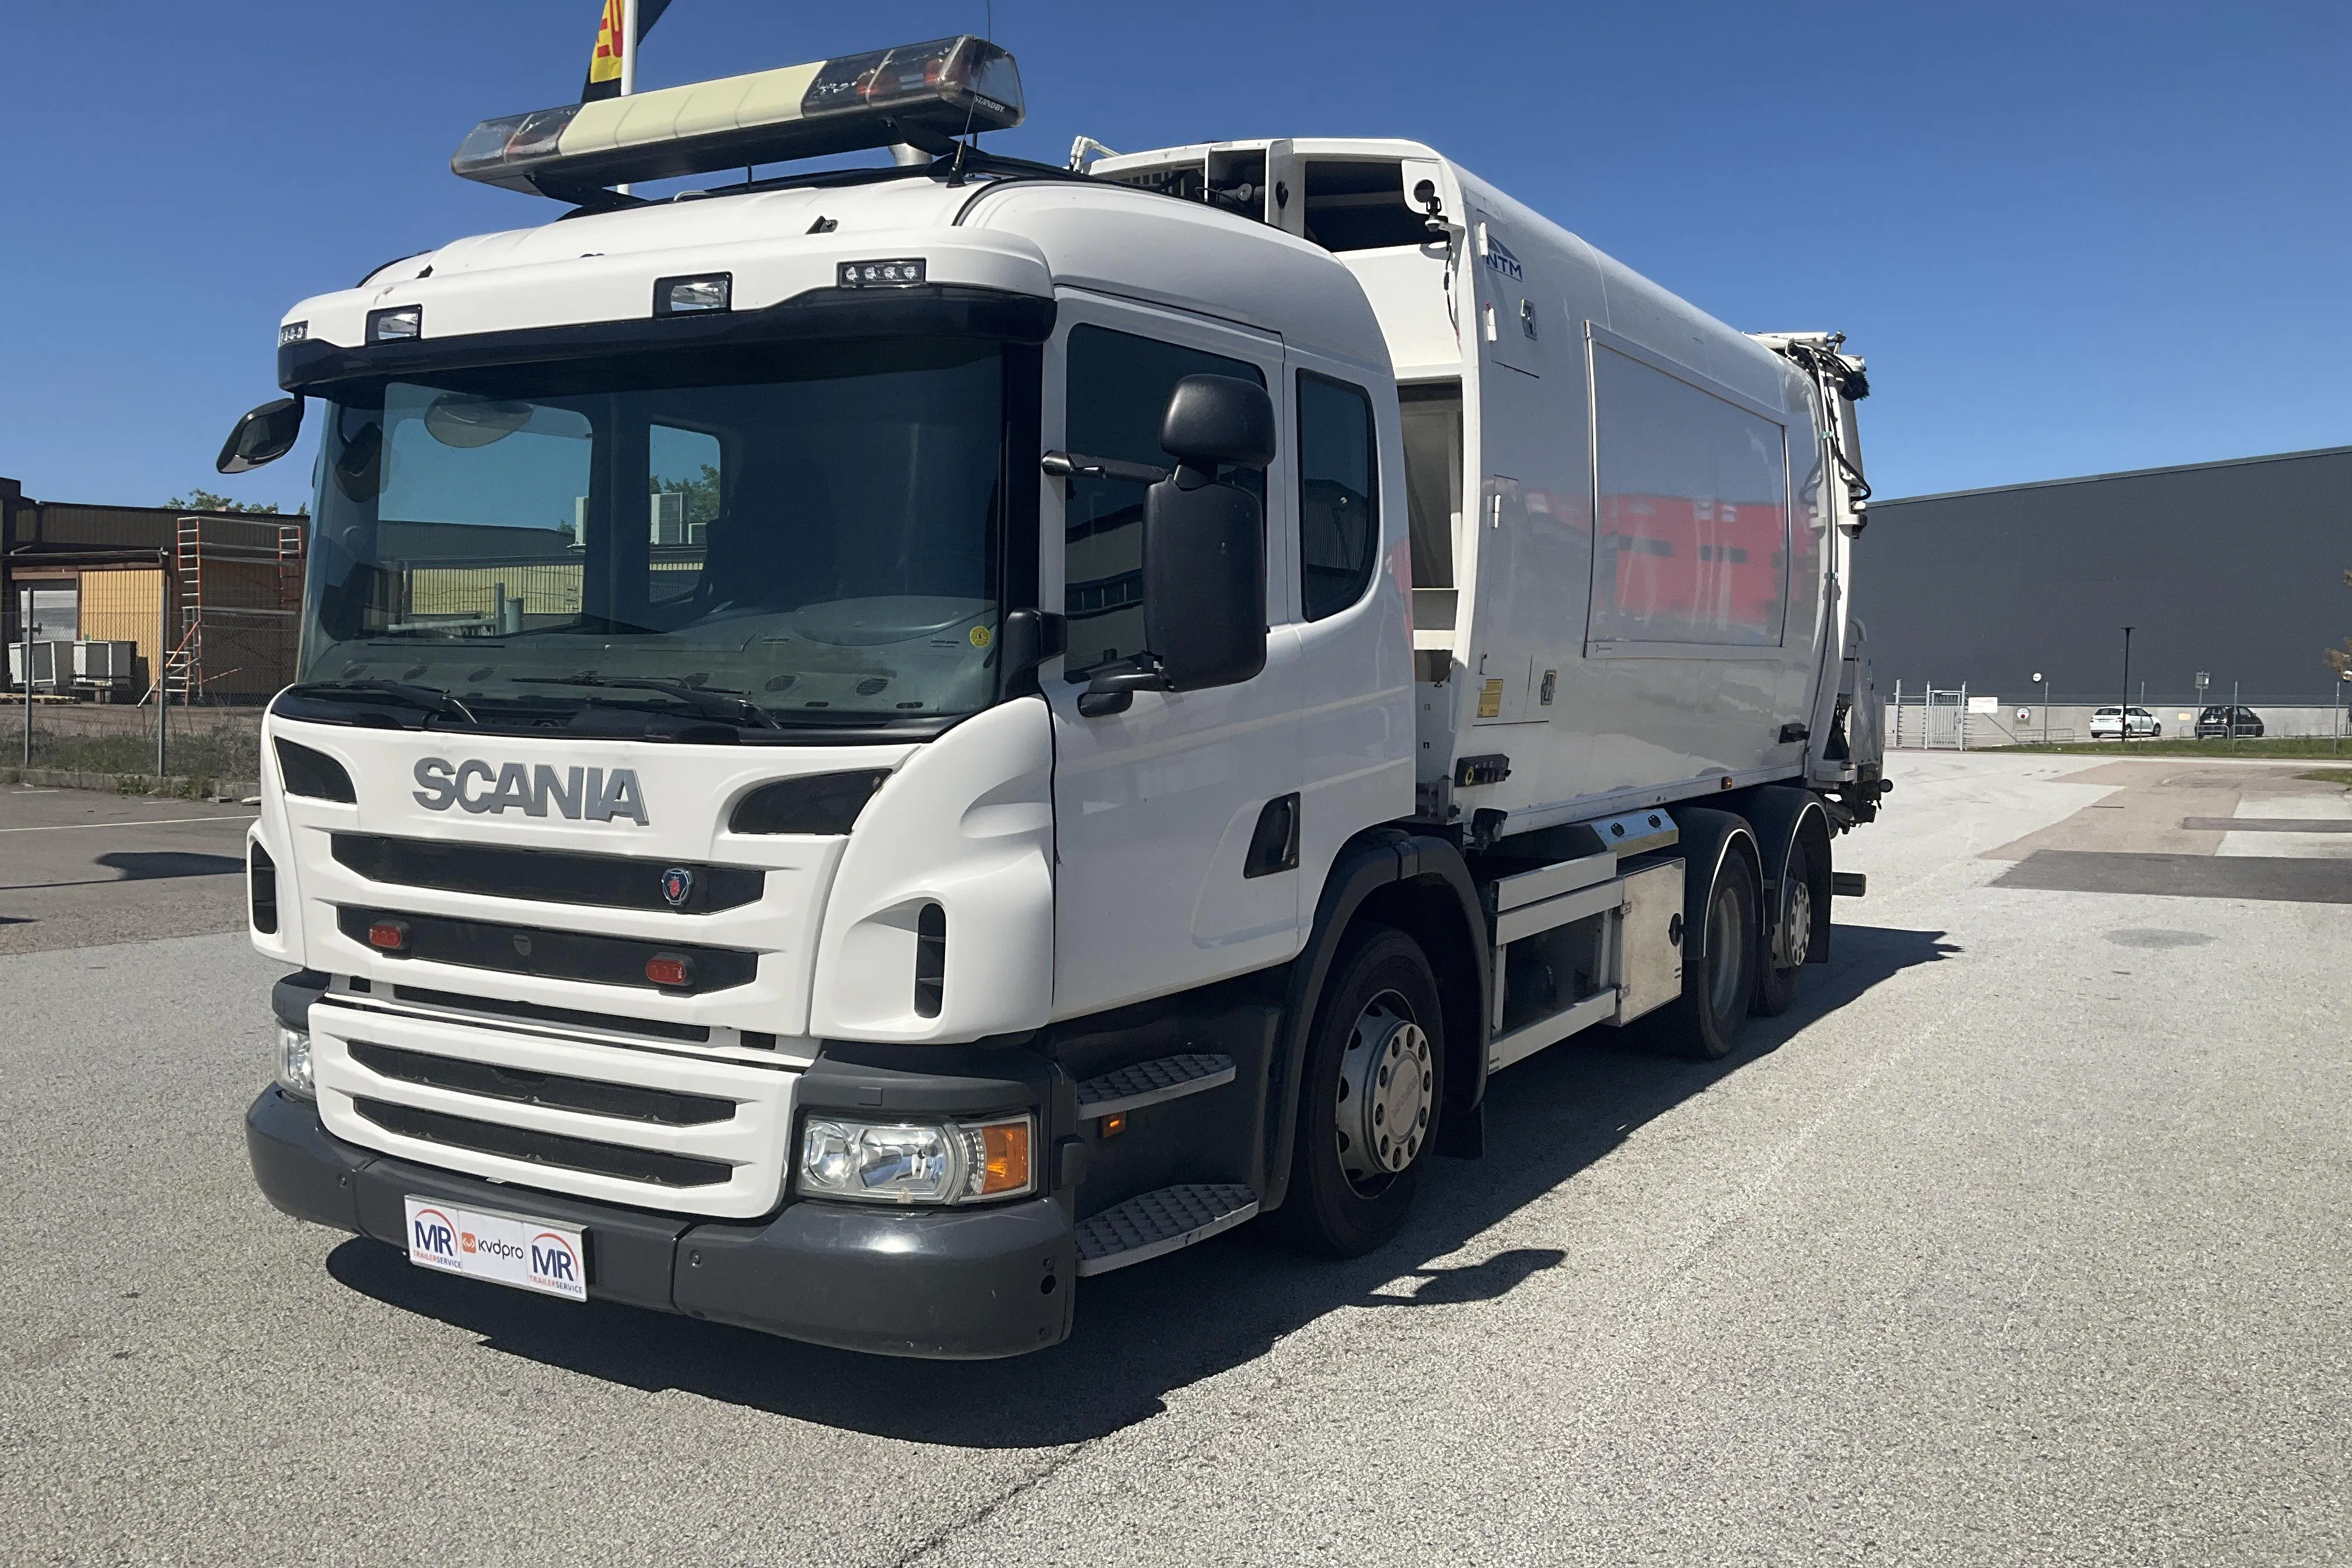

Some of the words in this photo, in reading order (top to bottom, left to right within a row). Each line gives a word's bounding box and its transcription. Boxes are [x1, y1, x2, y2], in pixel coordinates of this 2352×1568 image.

[974, 96, 1006, 113] STANDBY
[1486, 253, 1522, 280] NTM
[412, 757, 649, 826] SCANIA
[415, 1220, 453, 1256] MR
[478, 1239, 523, 1259] kvdpro
[532, 1244, 574, 1282] MR
